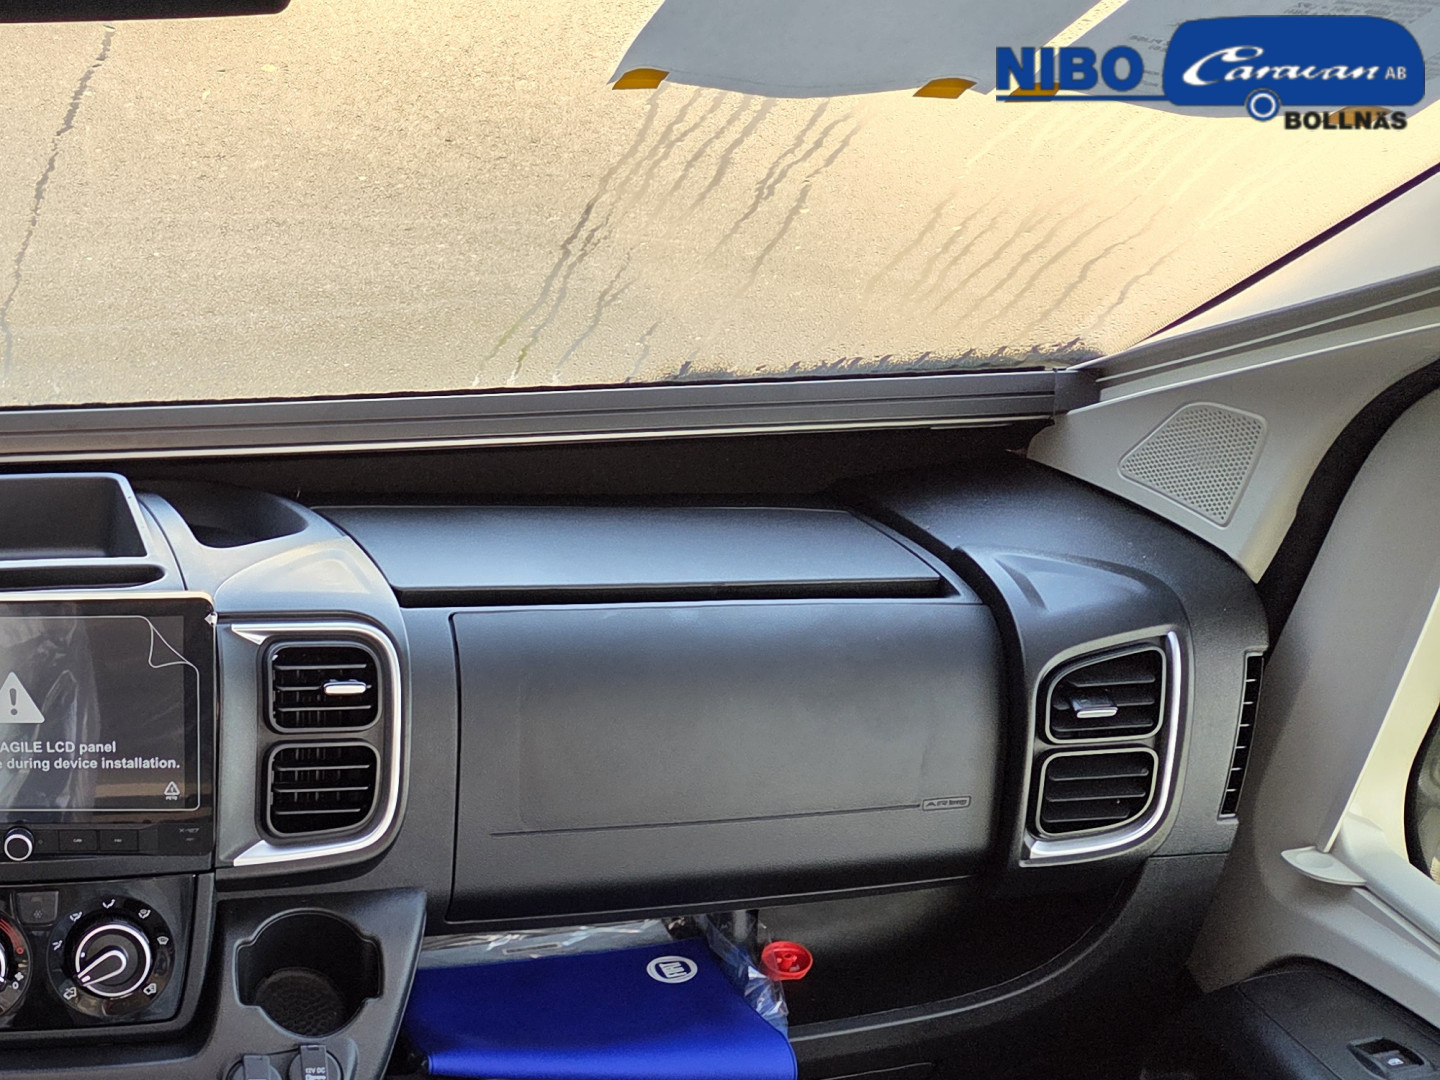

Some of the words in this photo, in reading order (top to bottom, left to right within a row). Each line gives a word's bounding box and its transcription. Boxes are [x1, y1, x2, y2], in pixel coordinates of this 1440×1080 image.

[46, 741, 76, 753] LCD
[79, 741, 117, 755] panel
[6, 758, 50, 772] during
[54, 758, 98, 769] device
[101, 757, 180, 769] installation.
[11, 981, 20, 990] 0
